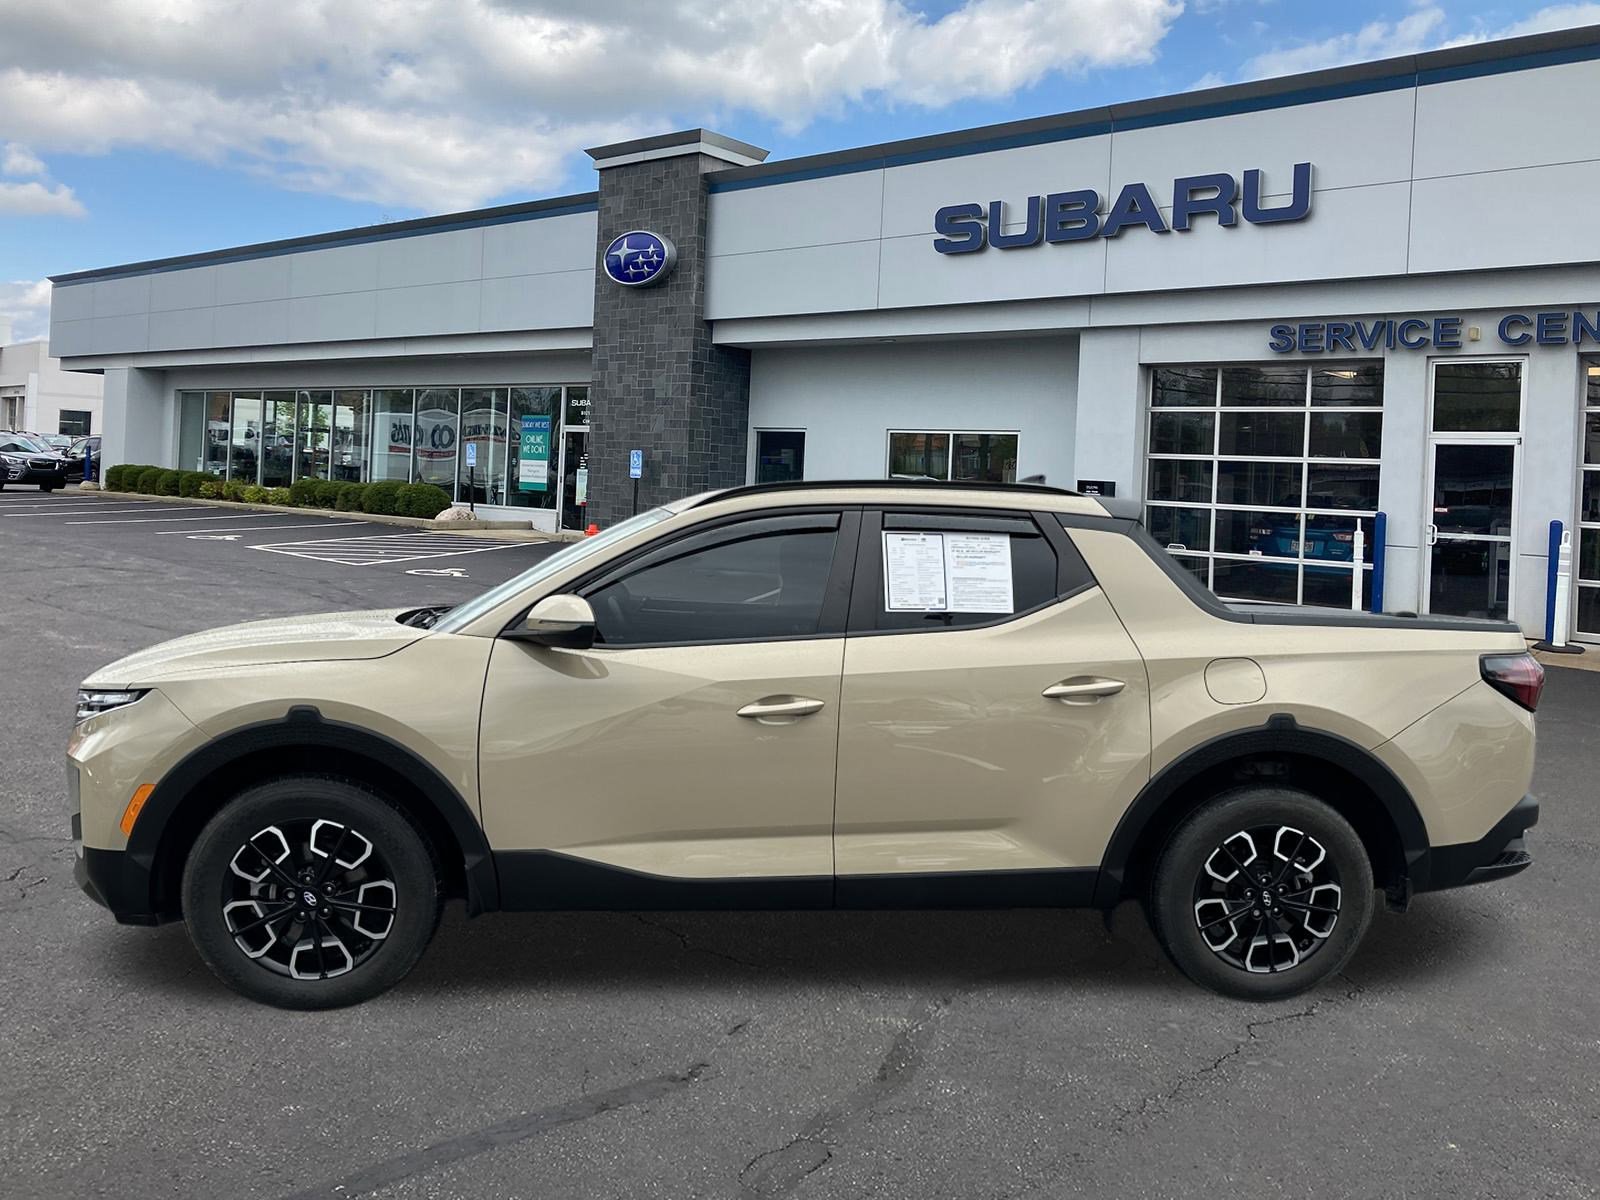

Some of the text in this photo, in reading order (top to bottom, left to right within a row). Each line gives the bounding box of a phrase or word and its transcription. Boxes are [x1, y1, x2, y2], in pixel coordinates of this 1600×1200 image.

[933, 162, 1313, 255] SUBARU
[1269, 312, 1600, 353] SERVICE CEN
